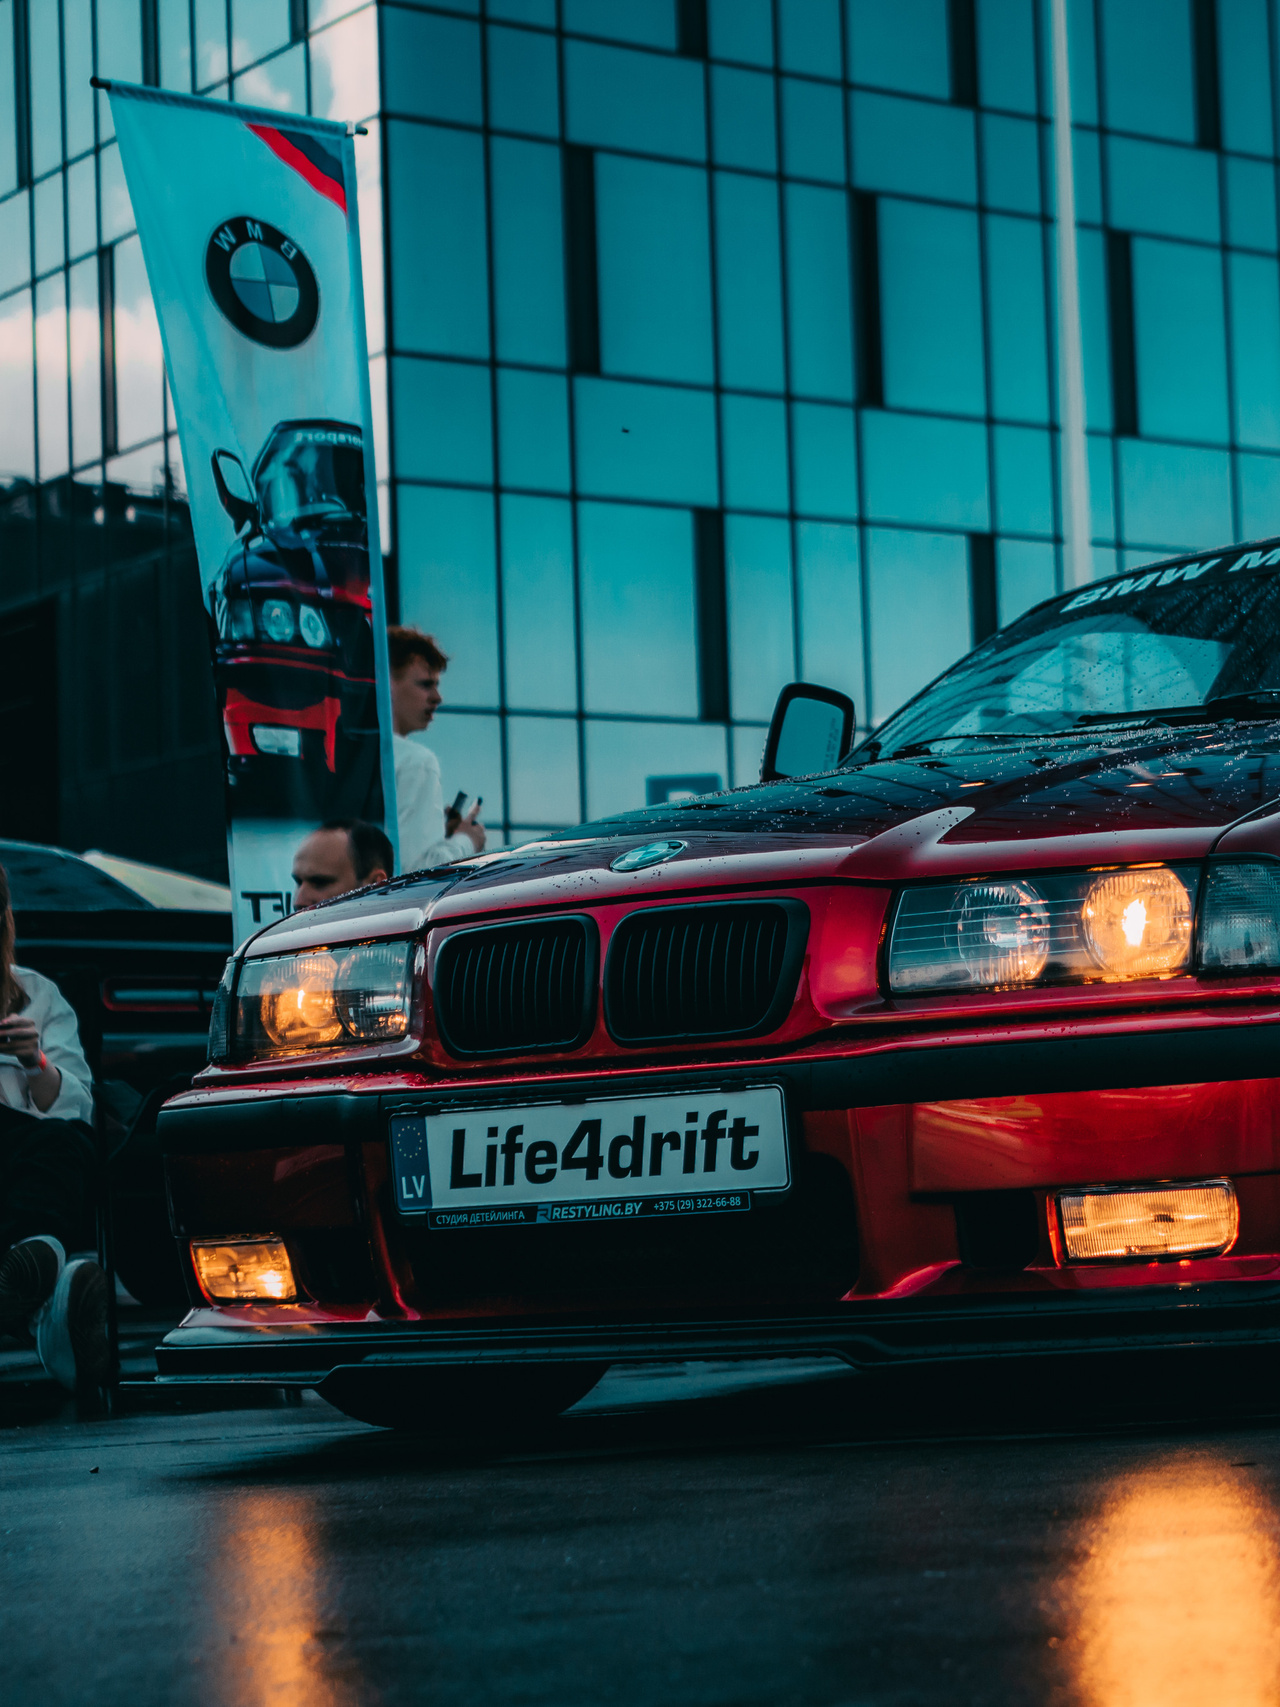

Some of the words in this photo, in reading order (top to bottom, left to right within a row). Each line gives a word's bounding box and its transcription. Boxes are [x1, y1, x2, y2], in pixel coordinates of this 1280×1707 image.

[1059, 558, 1223, 614] BMW
[449, 1108, 760, 1190] Life4drift
[402, 1175, 425, 1199] LV
[436, 1213, 468, 1226] СТУДИЯ
[469, 1209, 526, 1225] ДЕТЕЙЛИНГА
[552, 1201, 643, 1219] RESTYLING.BY
[654, 1200, 675, 1212] +375
[677, 1199, 694, 1211] (29)
[696, 1196, 741, 1209] 322-66-88
